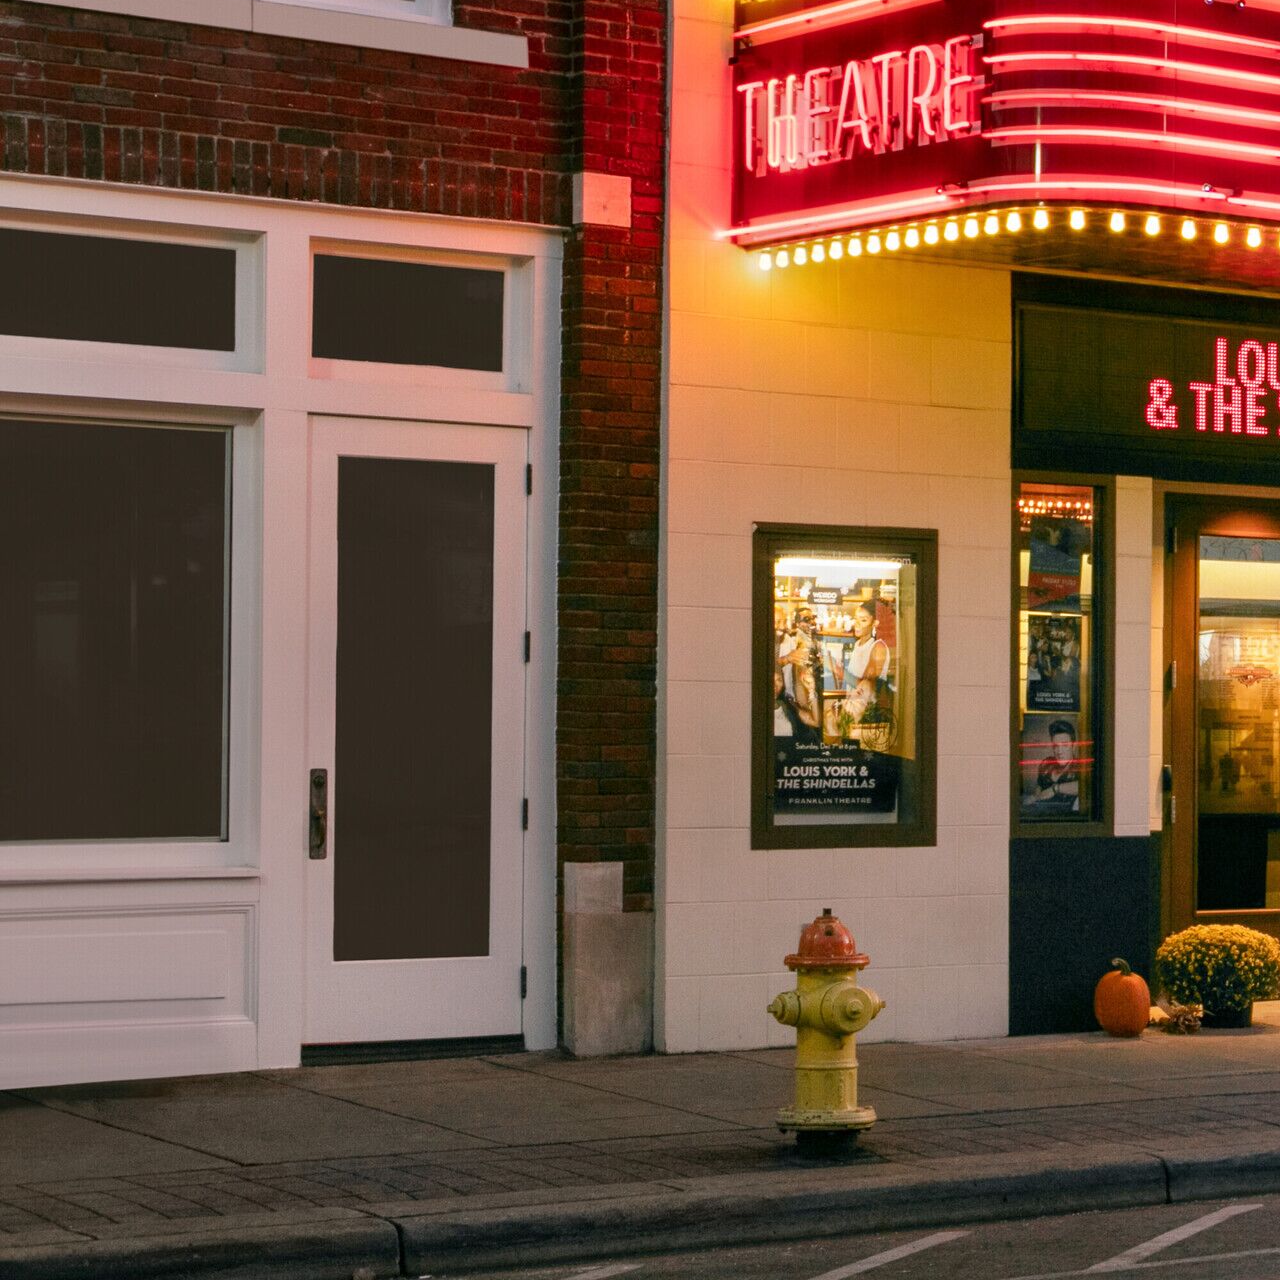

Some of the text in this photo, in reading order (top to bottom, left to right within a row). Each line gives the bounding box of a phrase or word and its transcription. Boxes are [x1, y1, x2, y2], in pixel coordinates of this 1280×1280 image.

[737, 33, 985, 178] THEATRE
[1145, 378, 1179, 430] &
[1189, 381, 1269, 436] THE
[777, 778, 876, 789] THE SHINDELLAS
[783, 766, 869, 777] LOUIS YORK &
